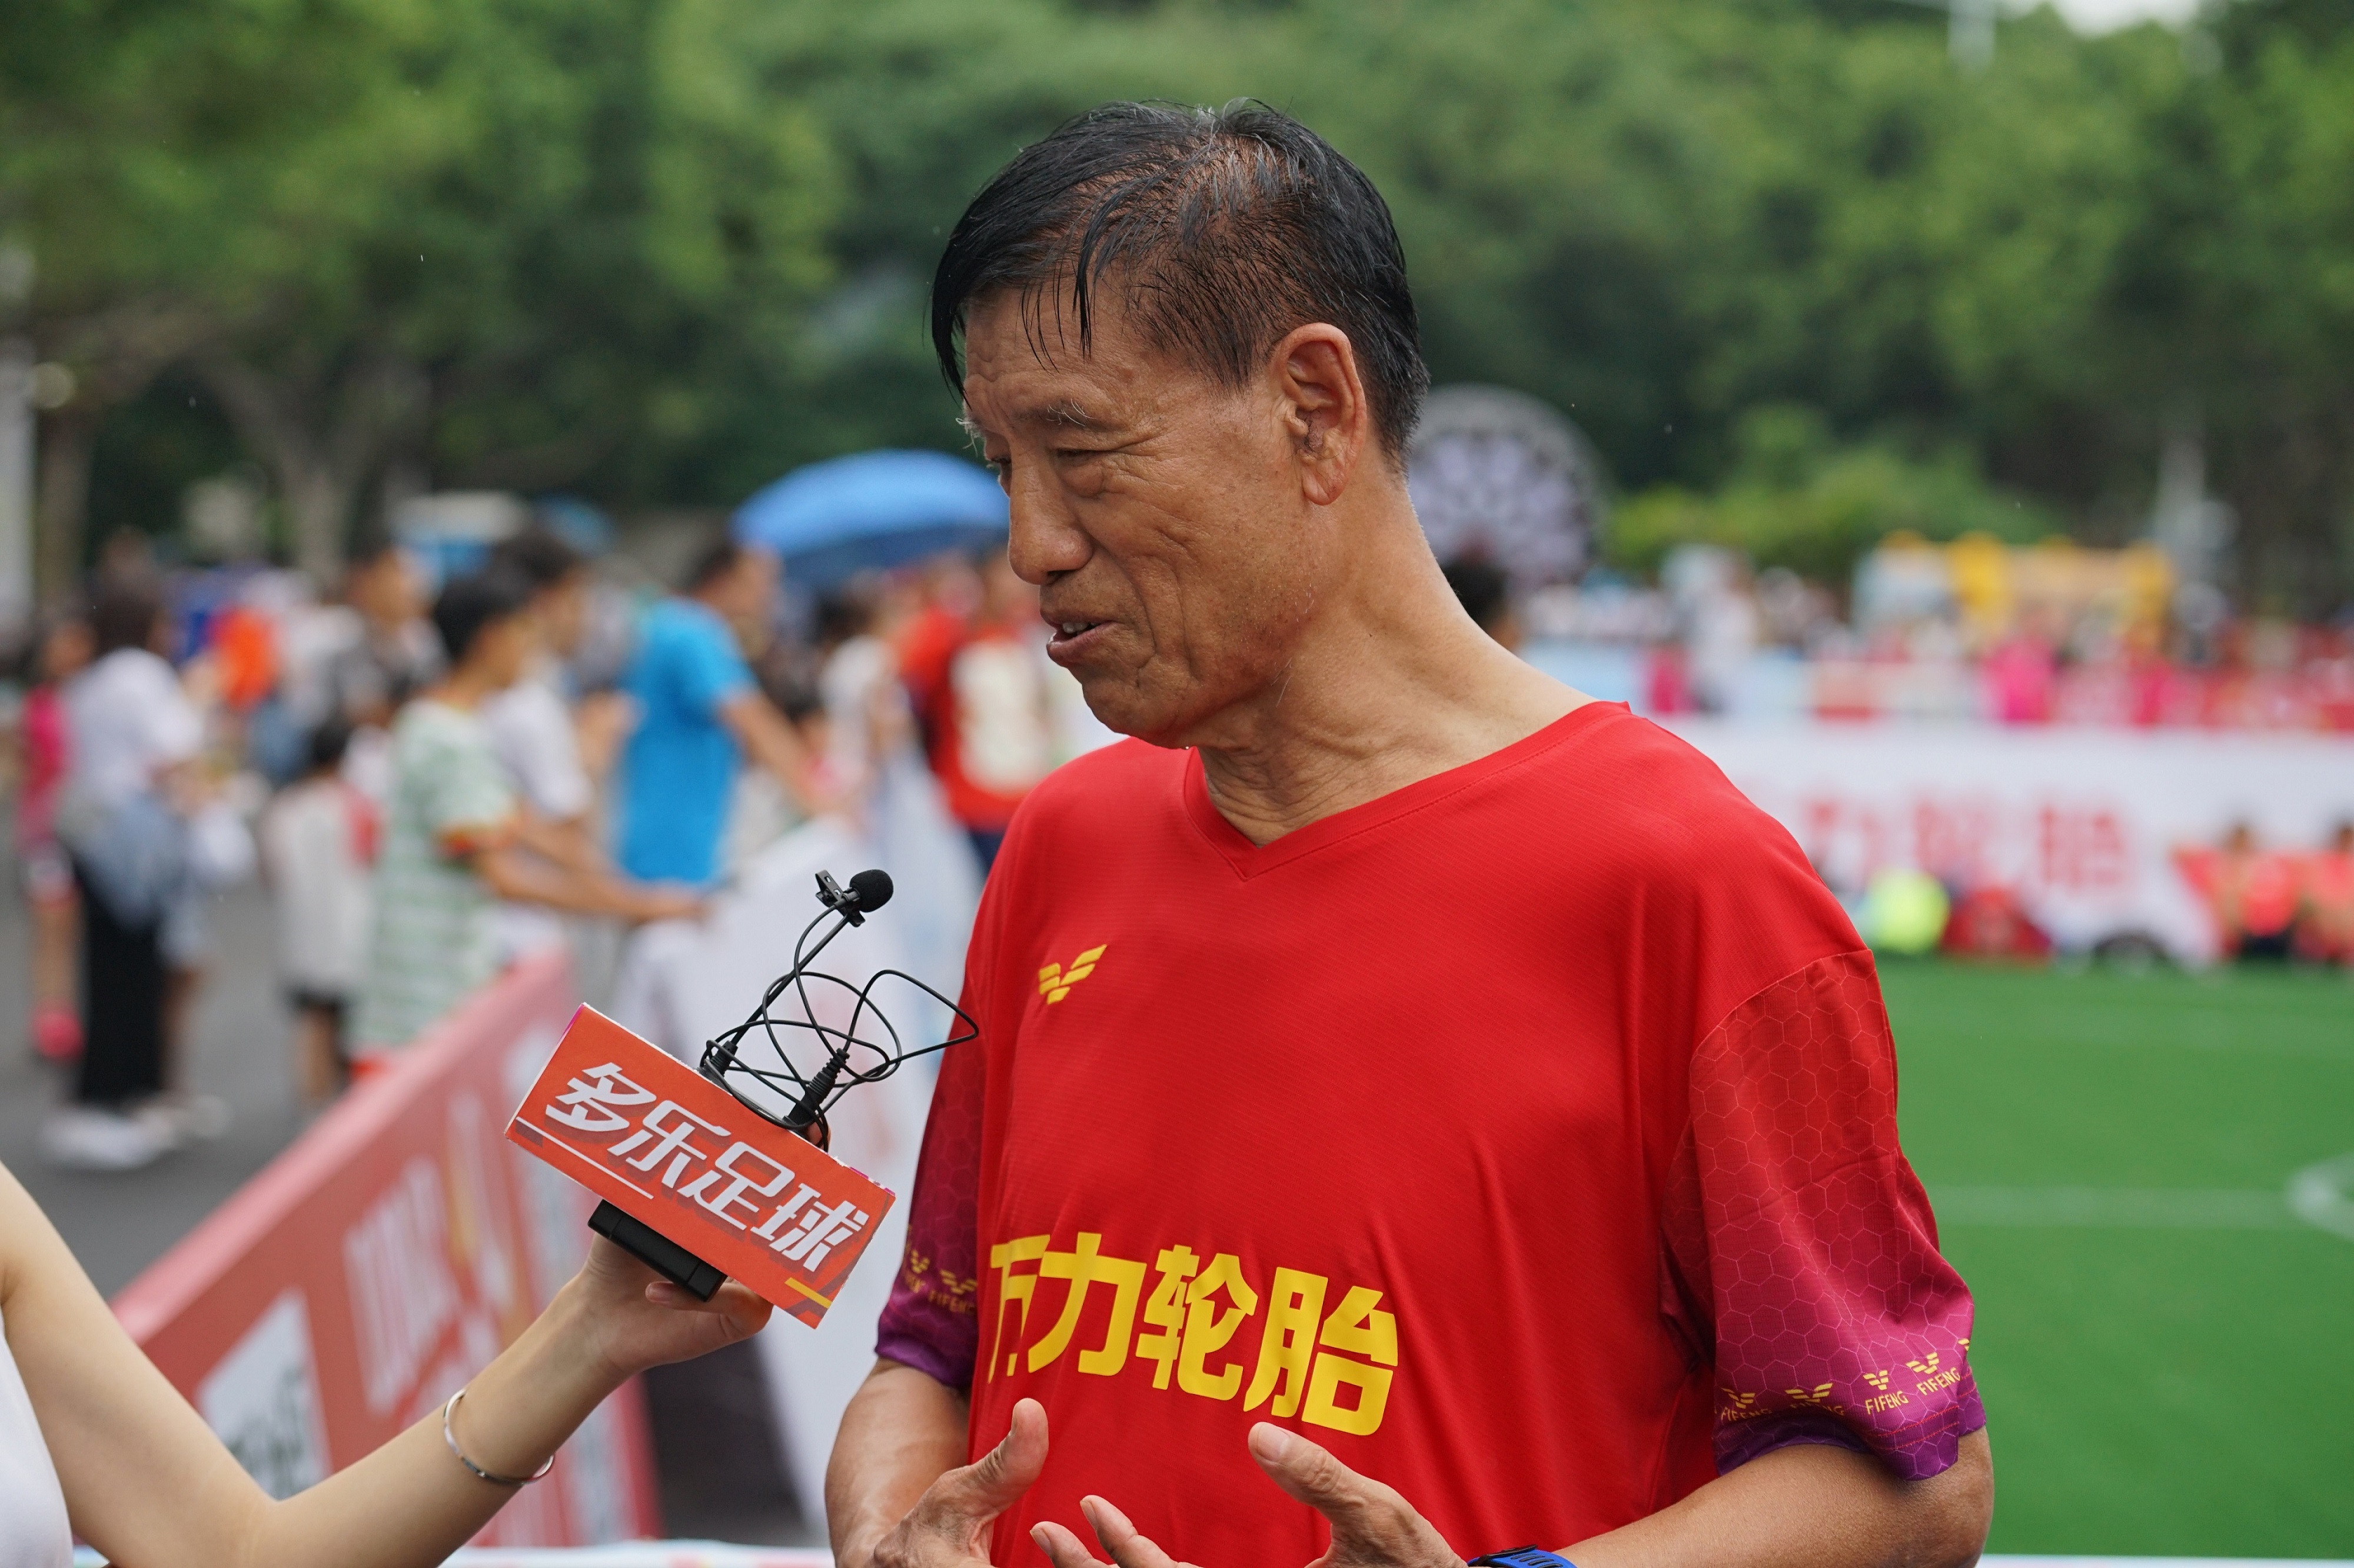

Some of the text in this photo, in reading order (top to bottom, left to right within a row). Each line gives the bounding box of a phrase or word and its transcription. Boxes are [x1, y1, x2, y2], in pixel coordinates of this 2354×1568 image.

[545, 1063, 869, 1272] 多乐足球
[988, 1231, 1399, 1436] 万力轮胎
[1916, 1367, 1961, 1396] FIFENG
[1865, 1390, 1909, 1415] FIFENG
